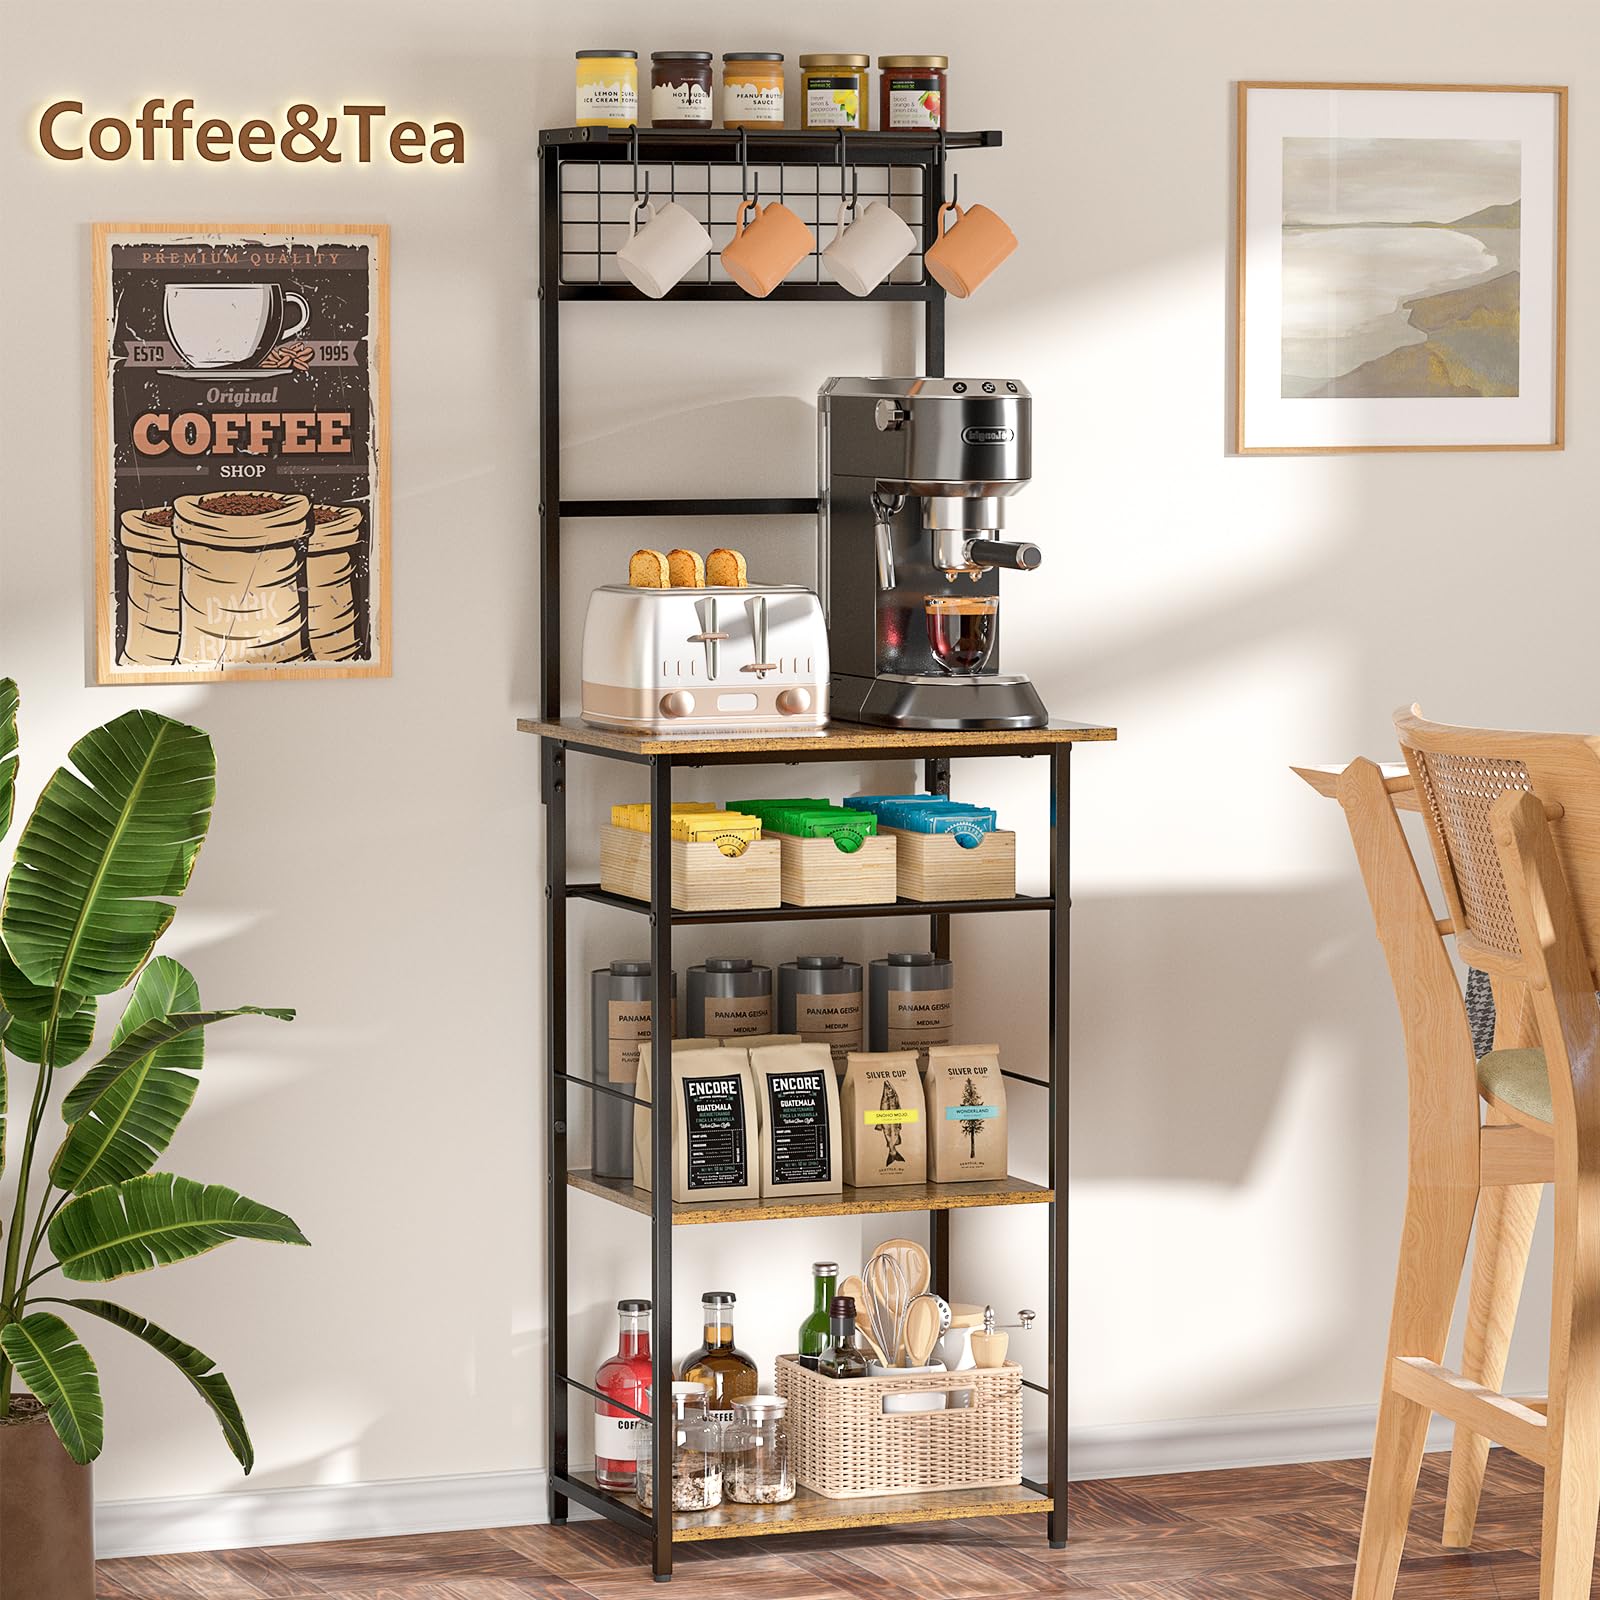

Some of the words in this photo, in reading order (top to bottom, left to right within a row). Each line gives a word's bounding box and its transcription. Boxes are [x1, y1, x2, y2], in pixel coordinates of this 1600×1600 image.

[39, 98, 465, 164] Coffee&Tea
[142, 252, 239, 265] PREMIUM
[250, 252, 341, 266] QUALITY
[133, 345, 164, 362] ESTD
[319, 345, 349, 361] 1995
[206, 386, 279, 408] Original
[132, 411, 352, 456] COFFEE
[219, 464, 267, 478] SHOP
[865, 1071, 890, 1079] SILVER
[892, 1070, 907, 1078] CUP
[947, 1067, 972, 1076] SILVER
[973, 1066, 988, 1075] CUP
[688, 1080, 738, 1097] ENCORE
[772, 1076, 821, 1092] ENCORE
[696, 1103, 732, 1112] GUATEMALA
[780, 1099, 816, 1107] GUATEMALA
